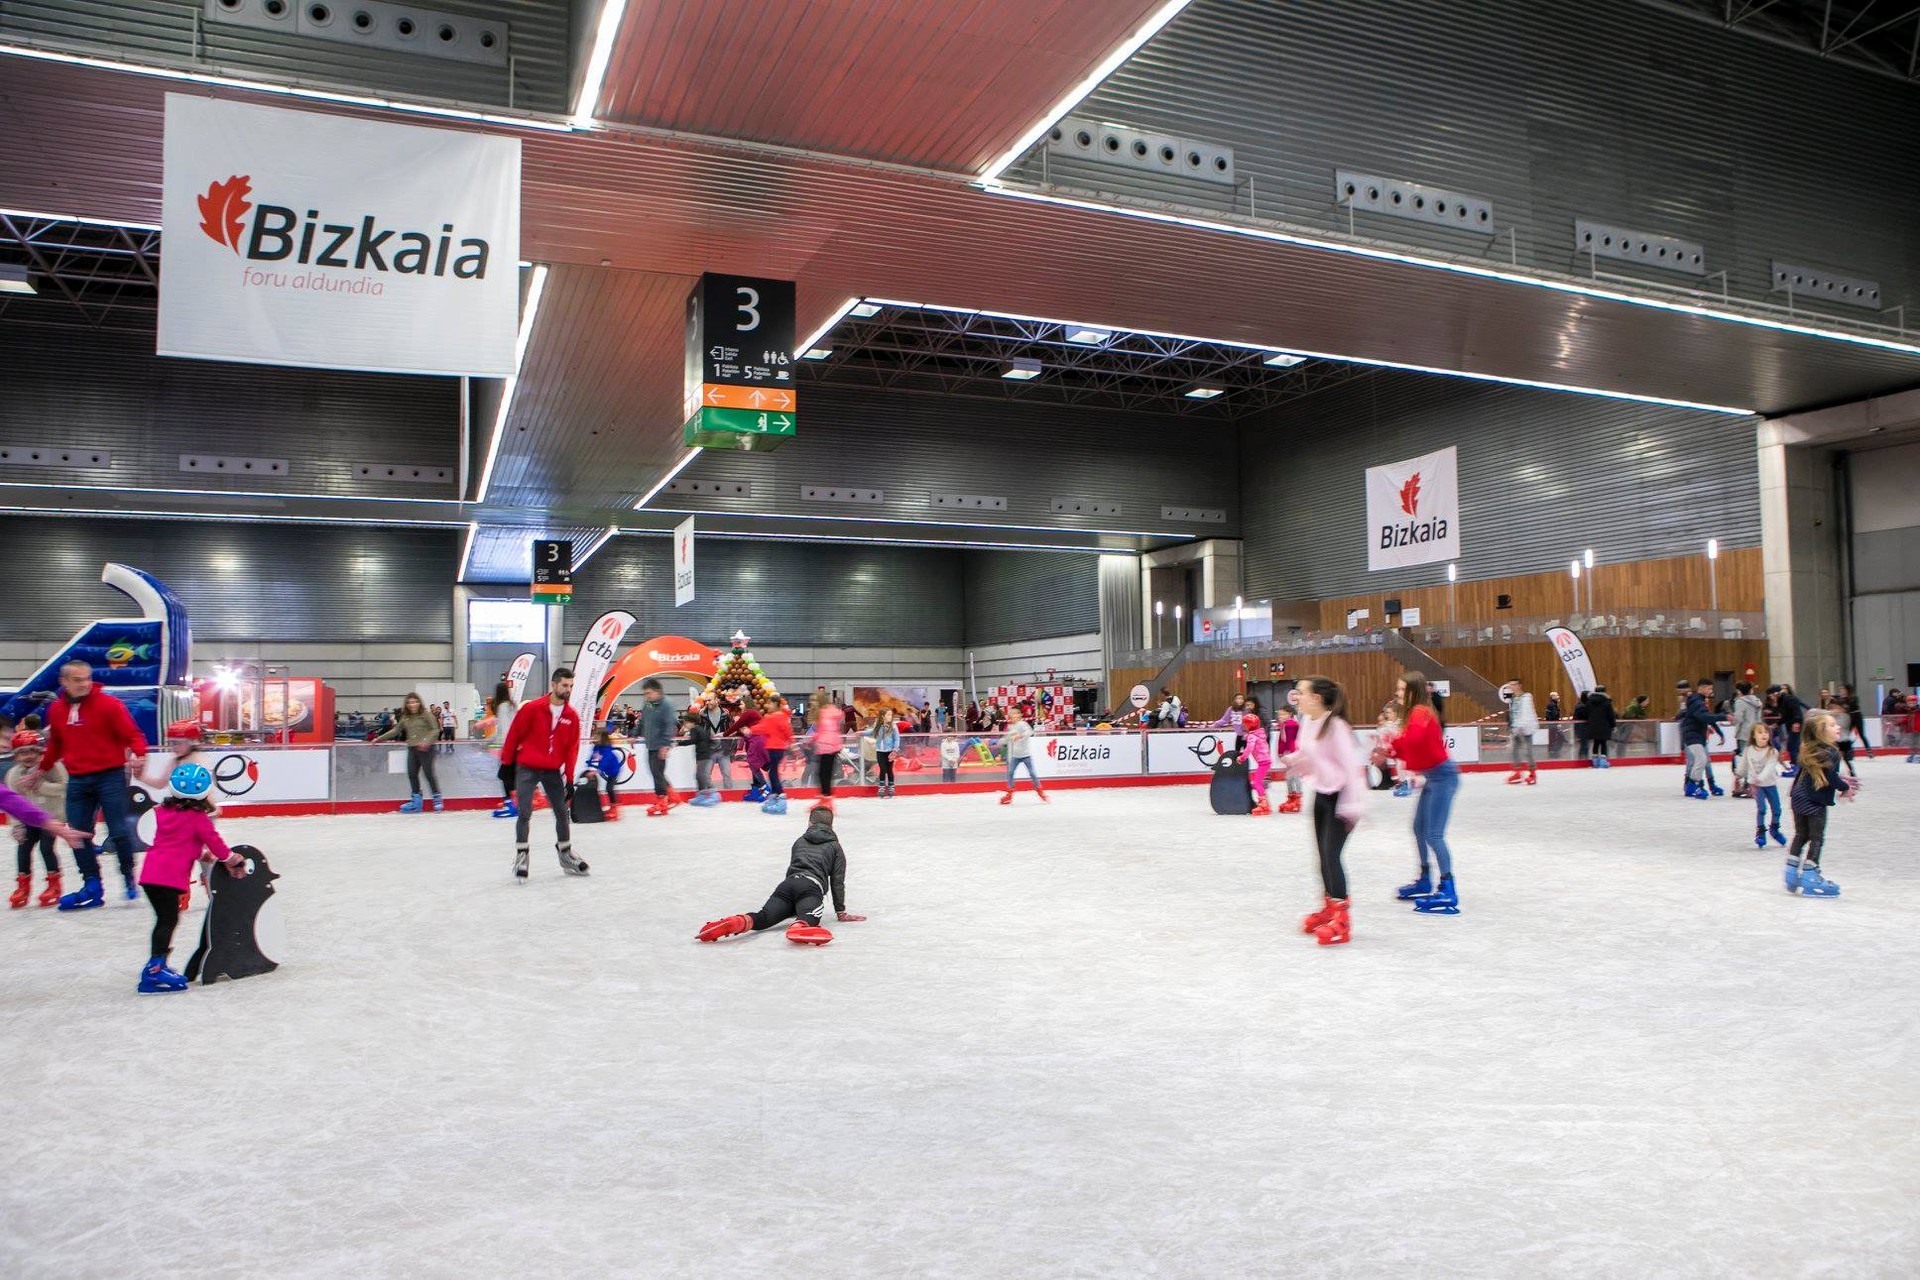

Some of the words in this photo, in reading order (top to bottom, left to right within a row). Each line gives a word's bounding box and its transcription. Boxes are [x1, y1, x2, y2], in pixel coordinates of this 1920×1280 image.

[247, 203, 490, 280] Bizkaia
[242, 267, 287, 287] foru
[292, 271, 385, 296] aldundia
[736, 287, 761, 331] 3
[713, 363, 721, 377] 1
[744, 365, 752, 379] 5
[1380, 516, 1448, 550] Bizkaia
[547, 543, 559, 562] 3
[587, 640, 613, 660] ctb
[658, 653, 700, 662] Bizkaia
[1057, 744, 1111, 761] Bizkaia
